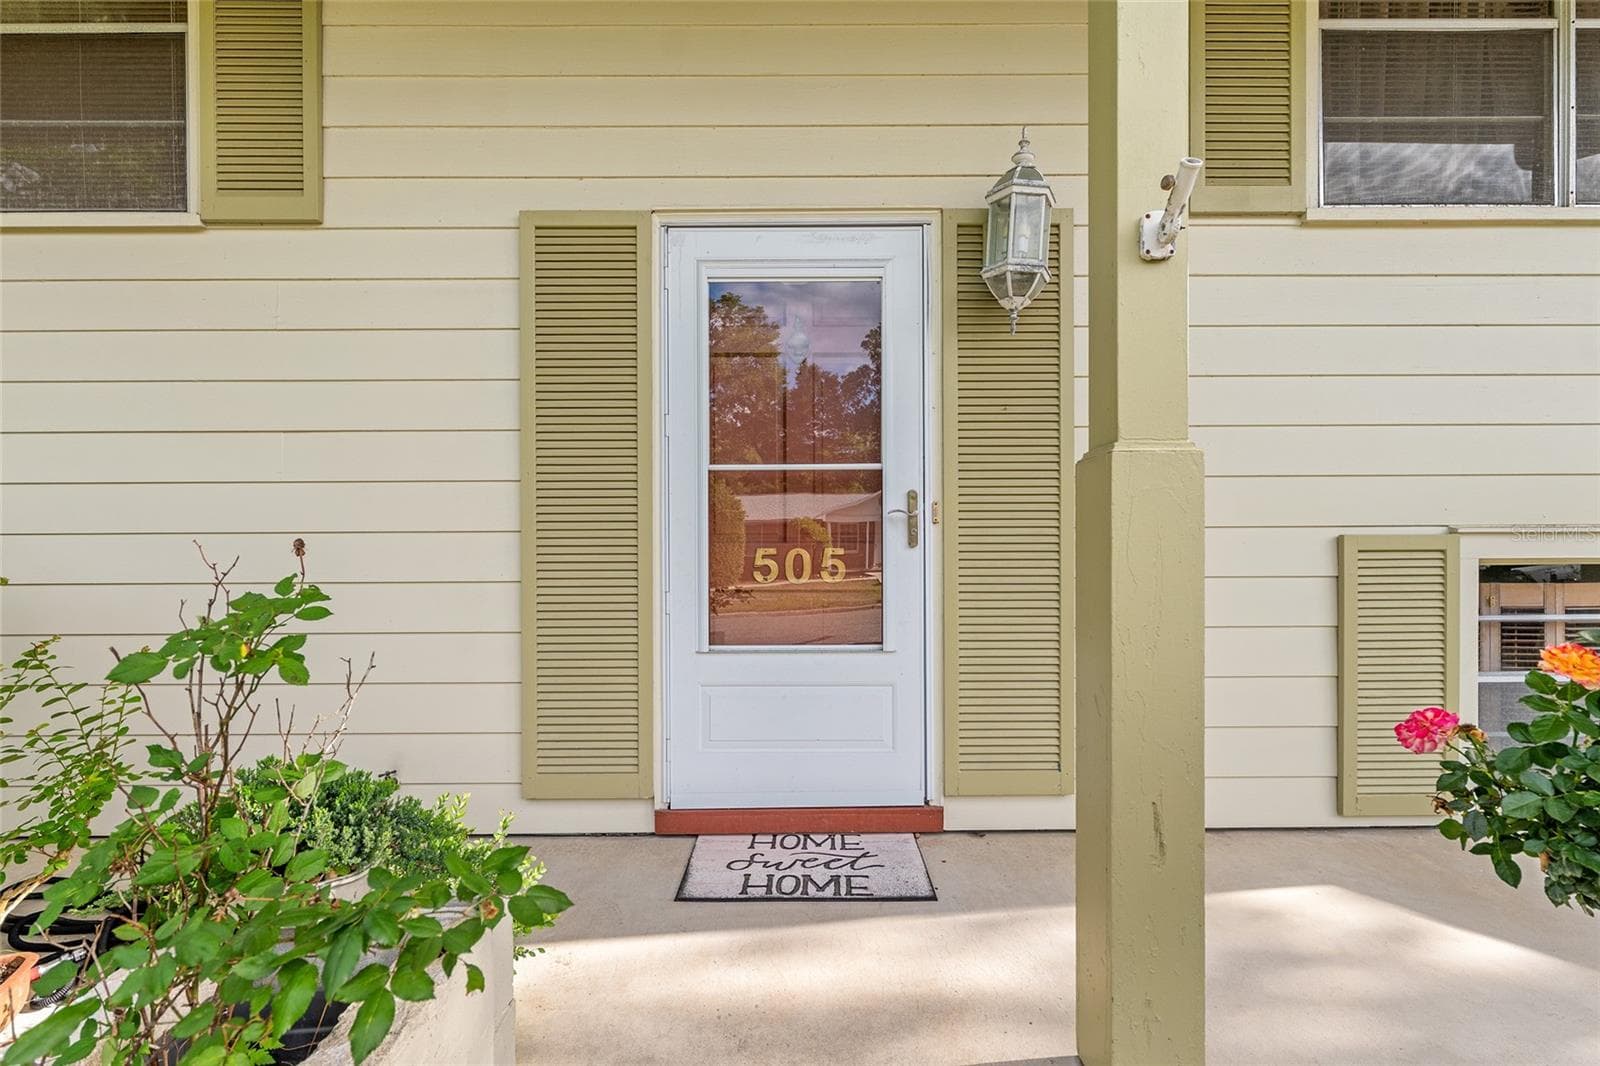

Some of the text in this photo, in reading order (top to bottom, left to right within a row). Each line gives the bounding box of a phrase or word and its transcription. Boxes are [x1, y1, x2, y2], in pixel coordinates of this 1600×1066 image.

[752, 547, 846, 584] 505
[748, 833, 865, 850] HOME
[738, 873, 874, 897] HOME
